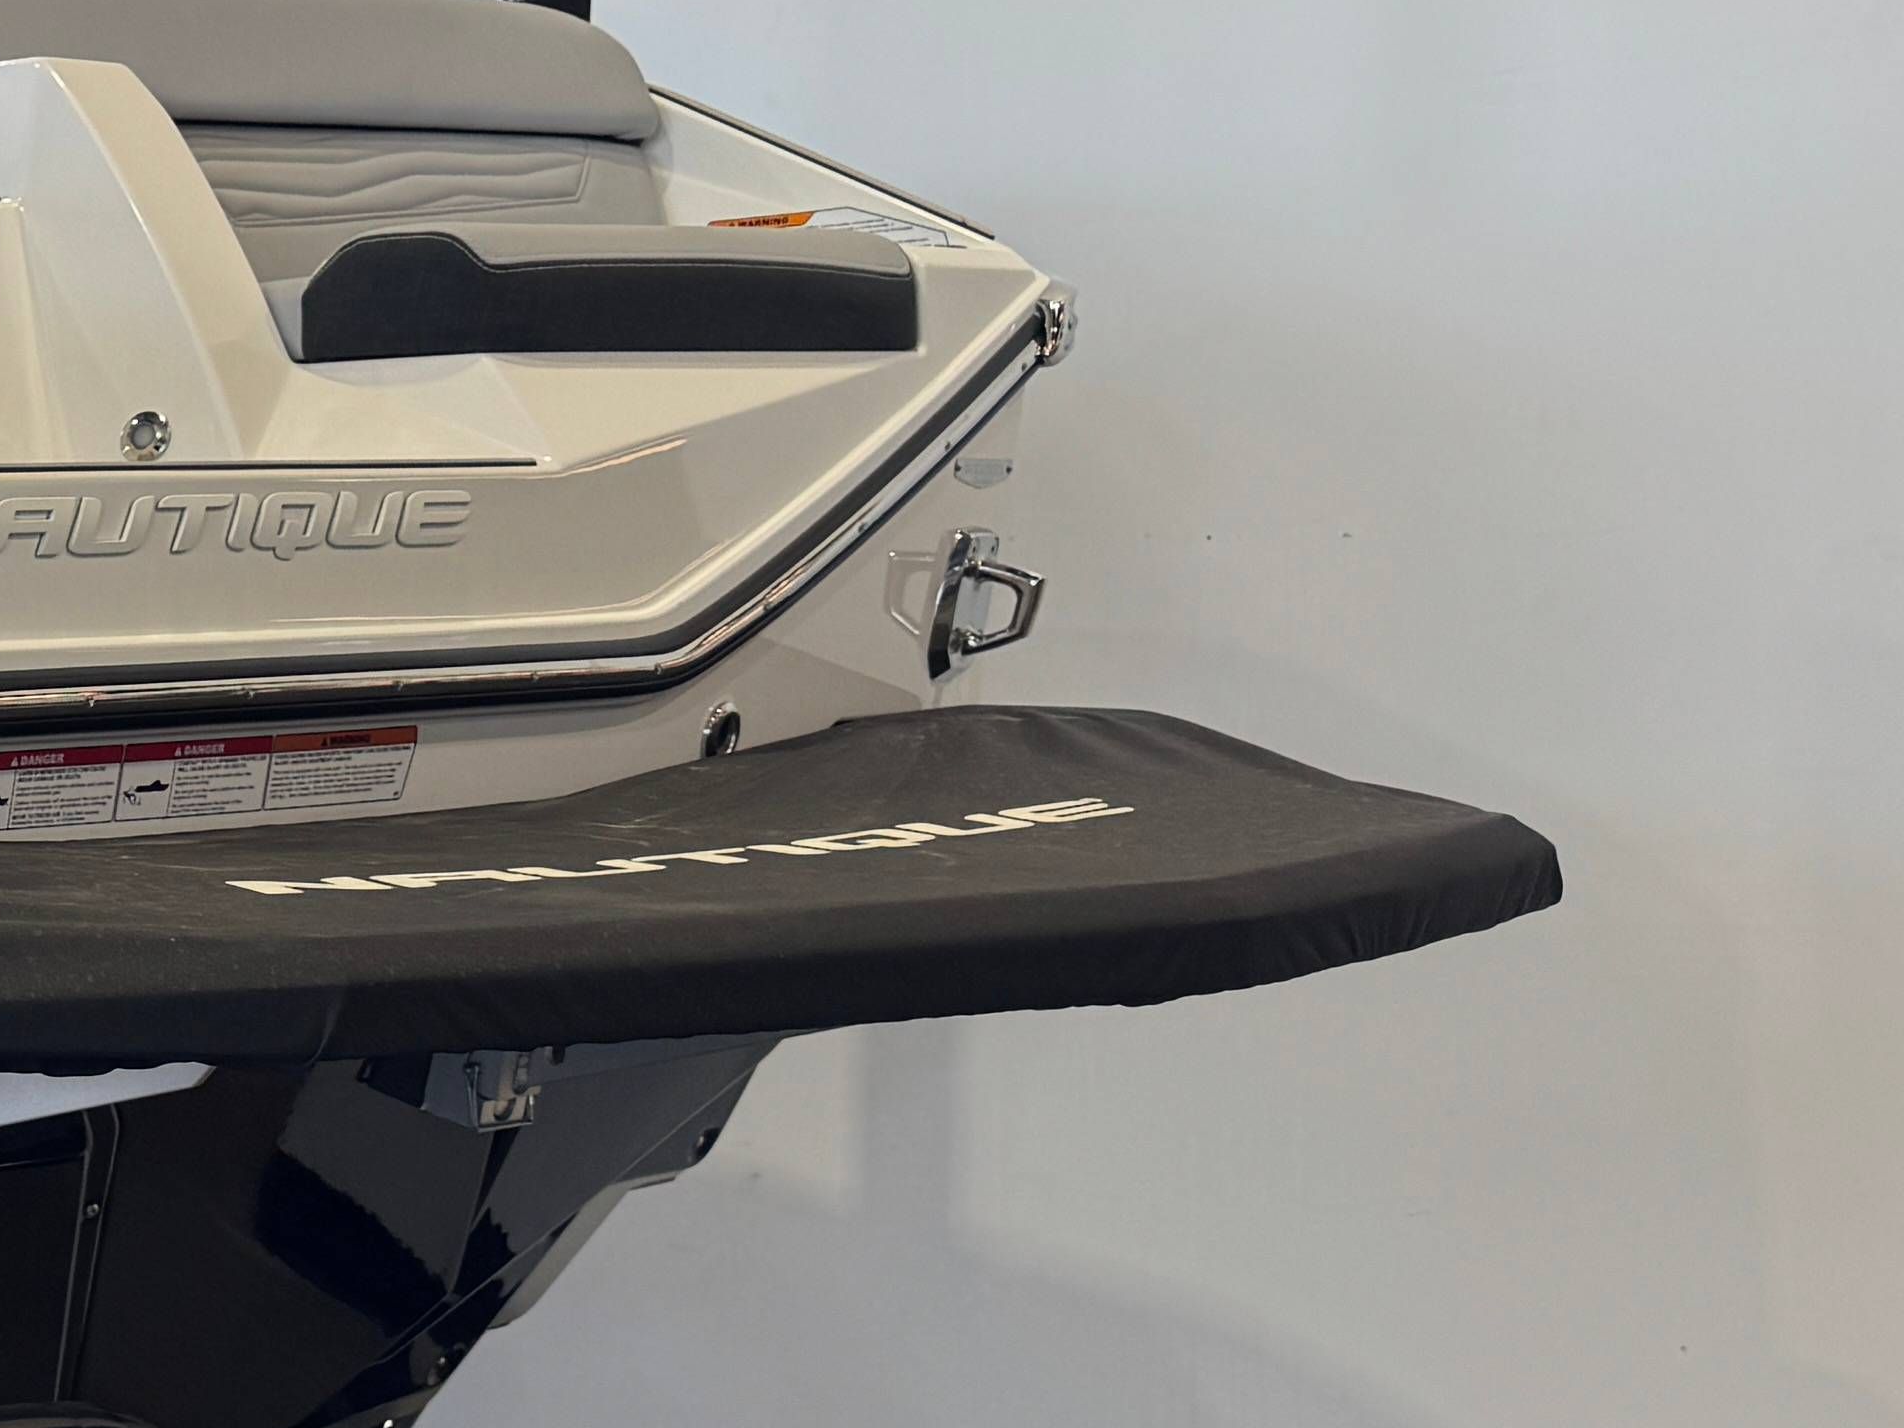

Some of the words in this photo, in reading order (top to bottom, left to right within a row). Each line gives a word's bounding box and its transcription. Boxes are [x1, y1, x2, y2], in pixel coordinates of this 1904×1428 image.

[183, 743, 225, 756] DANGER
[19, 753, 65, 767] DANGER
[225, 797, 1135, 895] NAUTIQUE
